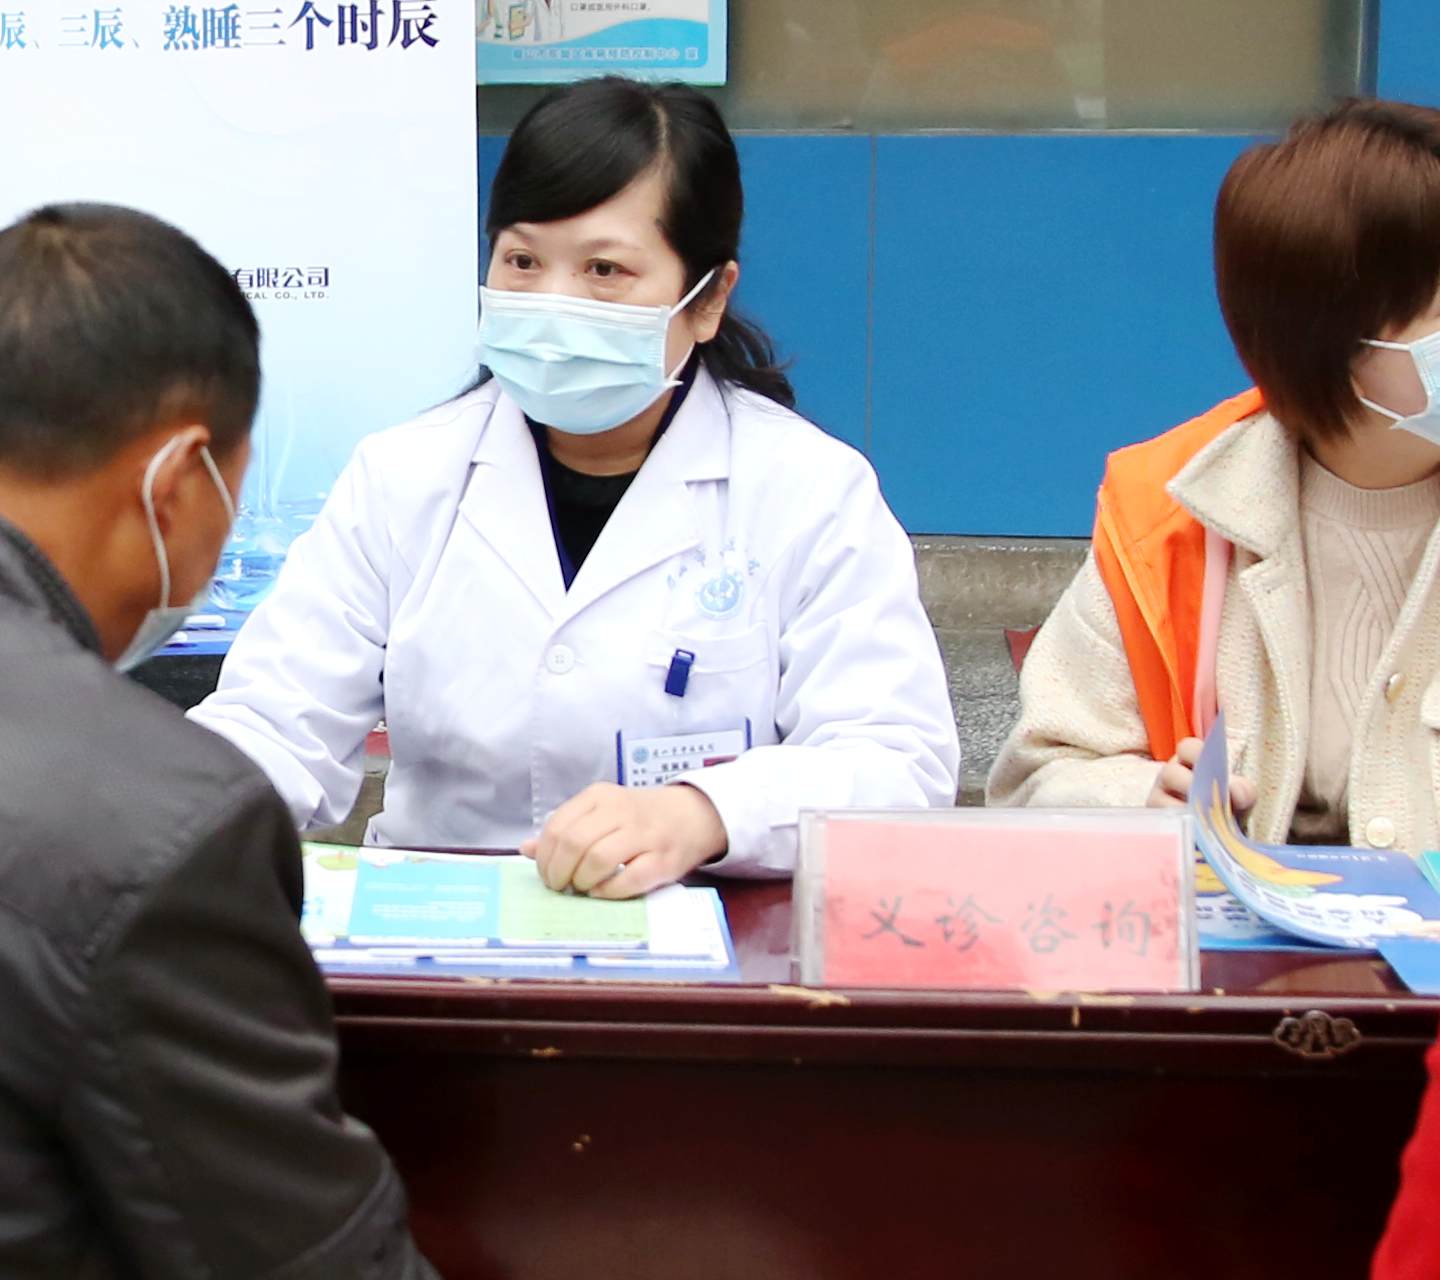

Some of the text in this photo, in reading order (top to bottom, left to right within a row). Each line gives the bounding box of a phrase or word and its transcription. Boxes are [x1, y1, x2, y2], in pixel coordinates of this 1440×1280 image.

[231, 267, 329, 288] 有限公司
[304, 291, 330, 300] LTD.
[860, 893, 1156, 958] 义诊咨询
